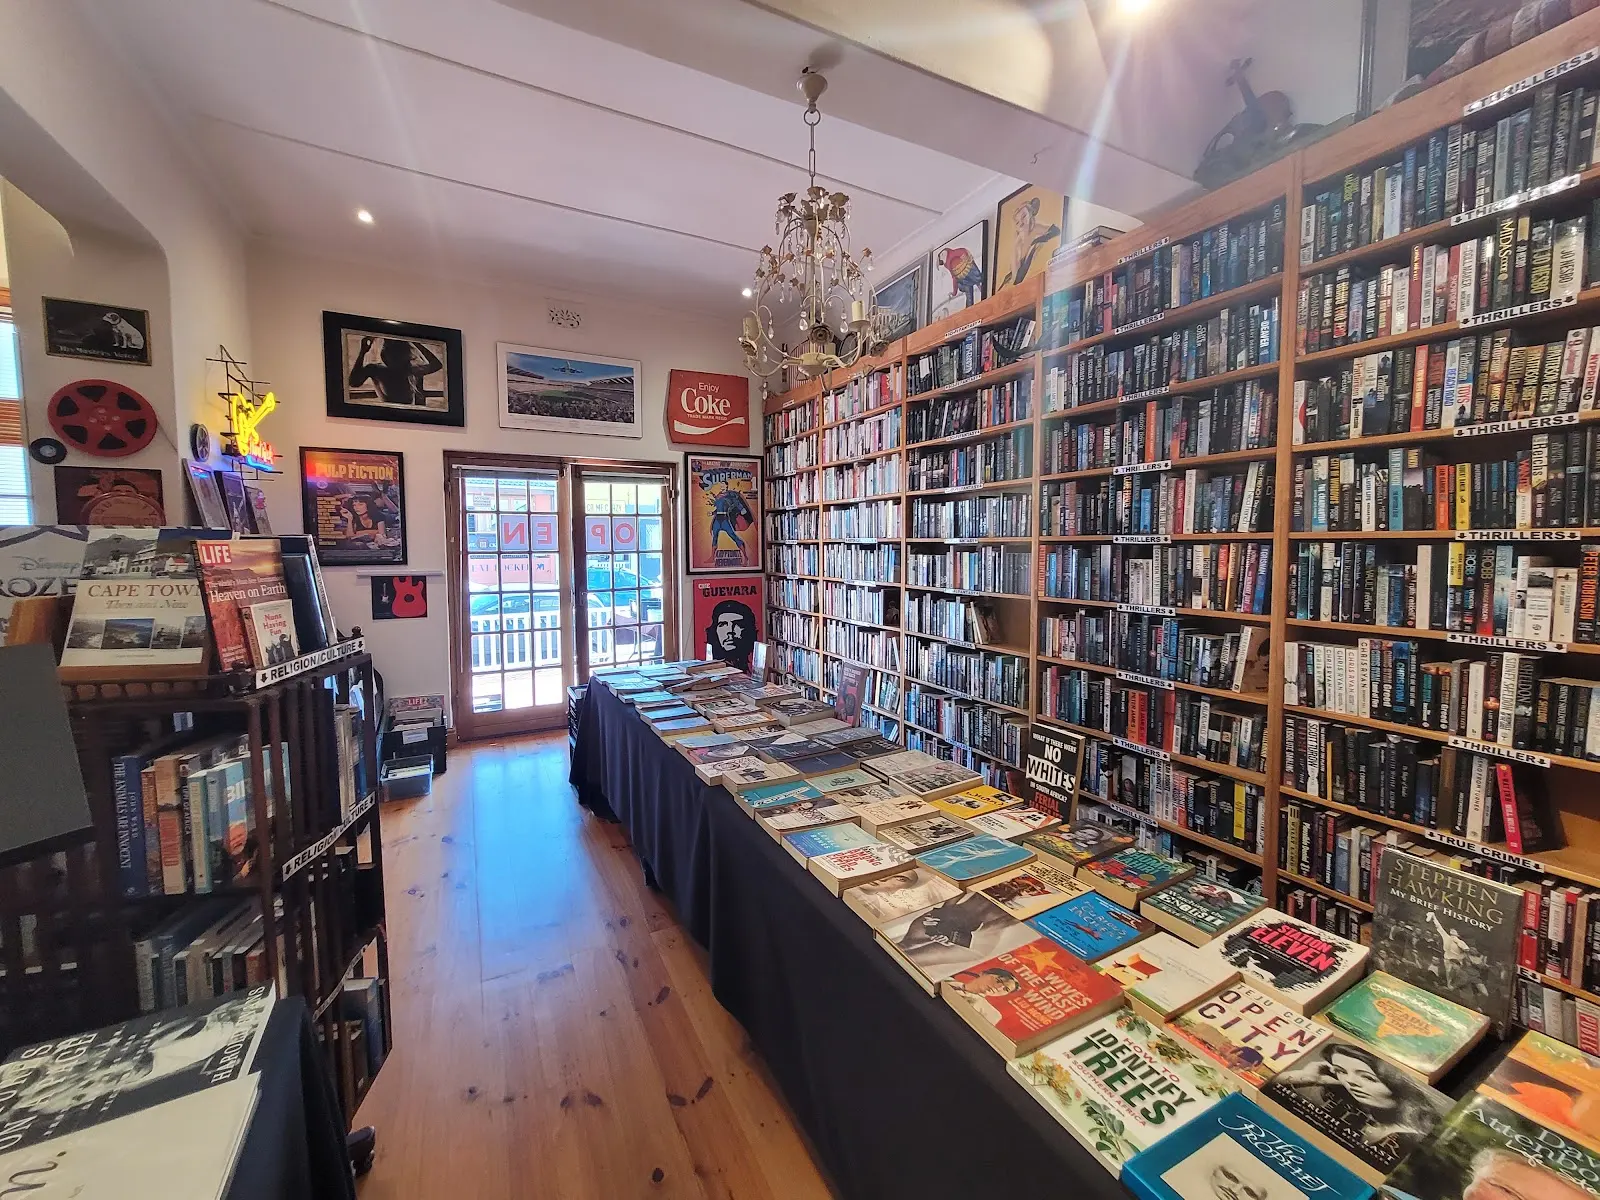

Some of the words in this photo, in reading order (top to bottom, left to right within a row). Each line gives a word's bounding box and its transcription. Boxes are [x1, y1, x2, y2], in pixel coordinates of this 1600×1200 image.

[1123, 240, 1164, 262] THRILLERS
[1530, 265, 1550, 294] NESBO
[1558, 260, 1576, 284] NESBO
[1119, 314, 1159, 333] THRILLERS
[1472, 298, 1564, 325] THRILLERS
[1259, 320, 1269, 348] DEAVER
[1446, 368, 1457, 389] BEACH
[1458, 352, 1470, 381] Patterson
[1523, 353, 1541, 386] PATTERSON
[698, 382, 720, 393] Enjoy
[1124, 387, 1164, 401] THRILLERS
[1376, 374, 1389, 402] Patterson
[1444, 390, 1455, 407] ROAD
[1457, 384, 1472, 404] TOYS
[1503, 379, 1519, 411] Patterson
[1556, 378, 1575, 411] Patterson
[681, 387, 731, 416] Coke
[1466, 415, 1566, 436] THRILLERS
[315, 462, 346, 479] PULP
[348, 461, 394, 480] FICTION
[1120, 462, 1162, 473] THRILLERS
[1532, 443, 1546, 476] Reichs
[703, 472, 753, 491] SUPERMAN
[1469, 531, 1566, 541] THRILLERS
[201, 545, 232, 564] LIFE
[1582, 550, 1600, 576] PETER
[88, 584, 140, 597] CAPE
[210, 588, 246, 603] Heaven
[248, 588, 260, 598] on
[260, 582, 286, 596] Earth
[703, 586, 757, 597] GUEVARA
[1364, 569, 1374, 590] VAULT
[1125, 606, 1166, 615] THRILLERS
[1579, 578, 1598, 620] ROBINSON
[263, 620, 287, 630] Having
[264, 613, 283, 621] Nuns
[270, 628, 283, 636] Fun
[1460, 634, 1548, 651] THRILLERS
[270, 641, 357, 681] RELIGION/CULTURE
[1360, 642, 1368, 666] CHRIS
[1124, 673, 1166, 688] THRILLERS
[1360, 667, 1368, 688] RYAN
[1396, 661, 1405, 684] CHRIS
[1505, 656, 1517, 682] SIDNEY
[1396, 684, 1405, 703] RYAN
[1501, 682, 1515, 710] SHELDON
[1517, 663, 1534, 703] SHELDON
[1032, 732, 1046, 743] WHAT
[1045, 736, 1050, 744] IF
[1050, 738, 1064, 749] THERE
[1063, 743, 1077, 754] WERE
[1308, 722, 1318, 743] SCOTT
[1044, 743, 1061, 763] NO
[1120, 740, 1162, 758] THRILLERS
[1308, 742, 1319, 768] TUROW
[1461, 740, 1538, 765] THRILLER
[114, 762, 127, 779] THE
[1027, 757, 1075, 791] WHITES
[115, 779, 129, 814] ANIMALS
[128, 791, 138, 813] JOHN
[1029, 780, 1036, 789] IN
[1035, 782, 1049, 795] SOUTH
[1049, 788, 1068, 803] AFRICA?
[1034, 791, 1060, 811] FERIAL
[117, 815, 129, 829] ARE
[1114, 803, 1154, 826] THRILLERS
[130, 817, 140, 839] WARD
[118, 829, 131, 869] INNOCENT
[1437, 833, 1476, 852] TRUE
[1480, 846, 1534, 868] CRIME
[1393, 857, 1498, 905] STEPHEN
[1156, 893, 1225, 926] ENGLISH
[1168, 890, 1209, 913] Watching
[1210, 910, 1227, 920] the
[1387, 872, 1503, 925] HAWKING
[1390, 888, 1405, 900] MY
[1409, 894, 1440, 912] BRIEF
[1443, 906, 1494, 932] HISTORY
[1250, 927, 1335, 972] ELEVEN
[1277, 924, 1333, 953] STATION
[997, 953, 1019, 969] OF
[1013, 964, 1045, 988] THE
[1038, 984, 1081, 1012] EAST
[1045, 971, 1093, 1007] WIVES
[1022, 989, 1066, 1021] WIND
[1237, 984, 1274, 1006] TEJU
[1283, 1011, 1326, 1036] COLE
[1197, 1002, 1301, 1062] CITY
[1218, 990, 1317, 1048] OPEN
[1579, 1014, 1599, 1052] PUBLIC
[1088, 1027, 1196, 1108] IDENTIFY
[1122, 1037, 1155, 1065] HOW
[1161, 1067, 1181, 1083] TO
[1069, 1036, 1177, 1126] TREES
[1072, 1059, 1120, 1099] SOUTHERN
[1115, 1099, 1148, 1128] AFRICA
[1275, 1082, 1304, 1099] THE
[1303, 1098, 1345, 1125] TRUTH
[1344, 1123, 1361, 1137] AT
[1361, 1138, 1396, 1162] LAST
[1217, 1114, 1342, 1196] PROPHET
[1262, 1128, 1306, 1165] The
